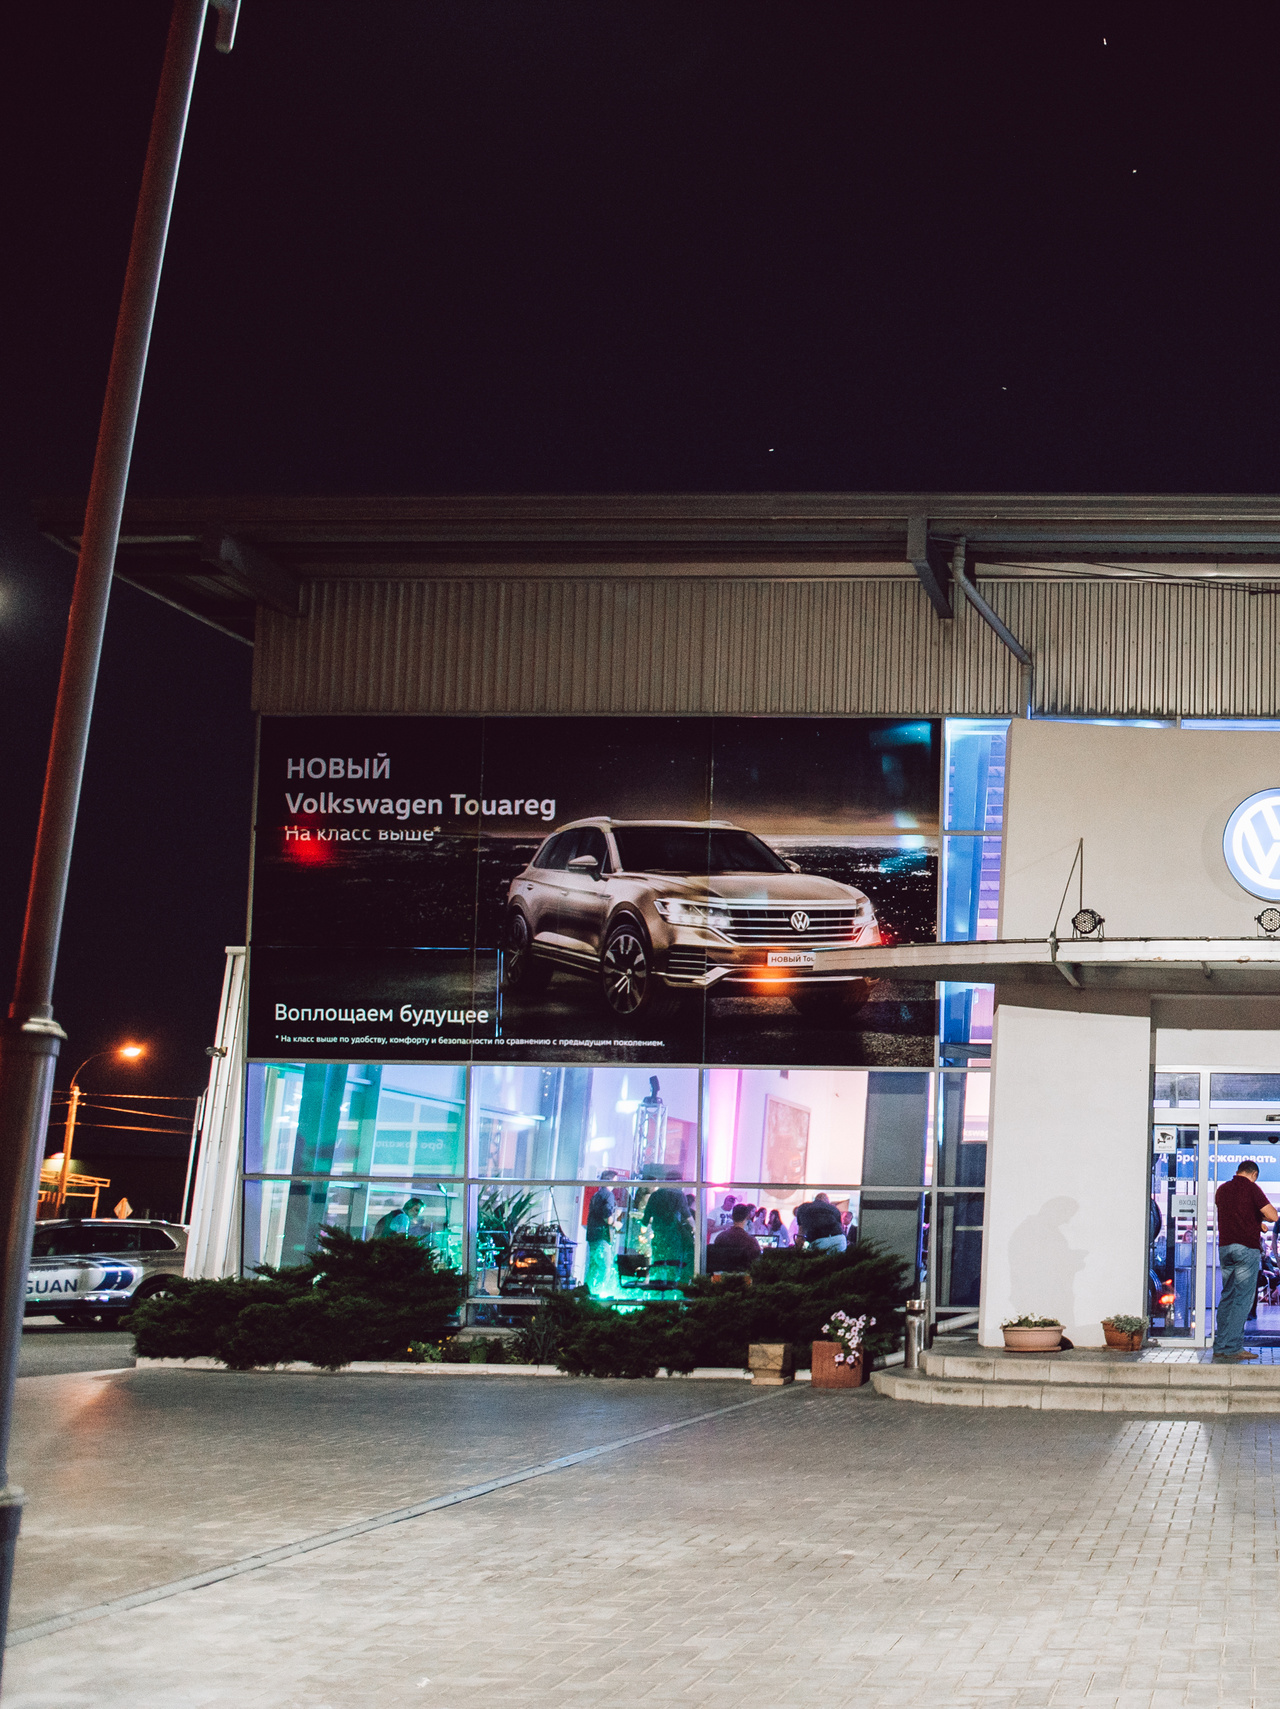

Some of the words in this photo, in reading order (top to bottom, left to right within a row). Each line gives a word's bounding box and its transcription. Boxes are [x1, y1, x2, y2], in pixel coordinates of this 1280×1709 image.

[286, 752, 391, 780] НОВЫЙ
[285, 792, 443, 820] Volkswagen
[450, 793, 557, 821] Touareg
[284, 825, 312, 841] На
[316, 828, 372, 841] класс
[274, 1003, 394, 1024] Воплощаем
[399, 1004, 489, 1027] будущее
[280, 1035, 292, 1043] На
[389, 1036, 430, 1046] комфорту
[438, 1036, 493, 1045] безопасности
[506, 1038, 551, 1046] сравнению
[558, 1039, 612, 1047] предыдущим
[25, 1279, 78, 1294] GUAN
